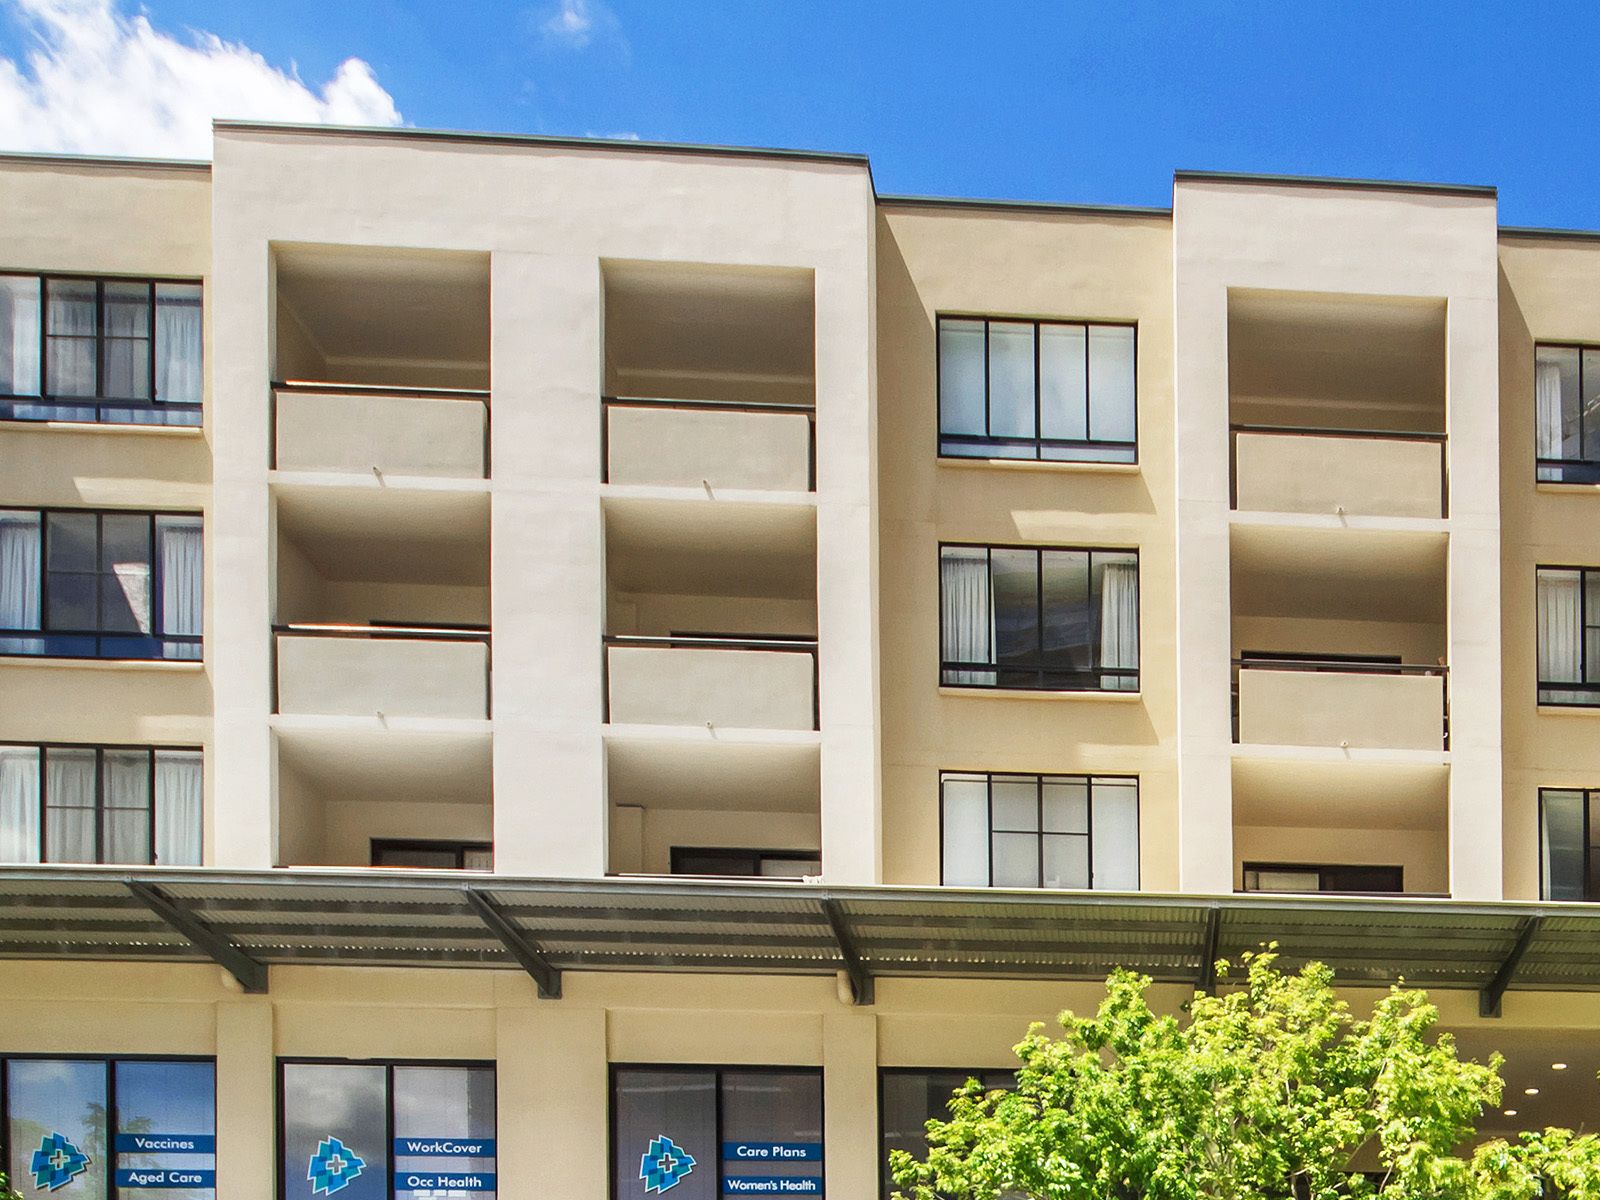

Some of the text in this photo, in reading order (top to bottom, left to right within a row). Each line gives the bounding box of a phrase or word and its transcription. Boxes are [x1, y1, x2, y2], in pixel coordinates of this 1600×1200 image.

[134, 1137, 195, 1150] Vaccines
[407, 1142, 482, 1154] WorkCover
[736, 1146, 807, 1158] Care Plans
[128, 1171, 203, 1185] Aged Care
[407, 1176, 482, 1188] Occ Health
[727, 1179, 816, 1191] Women's Health
